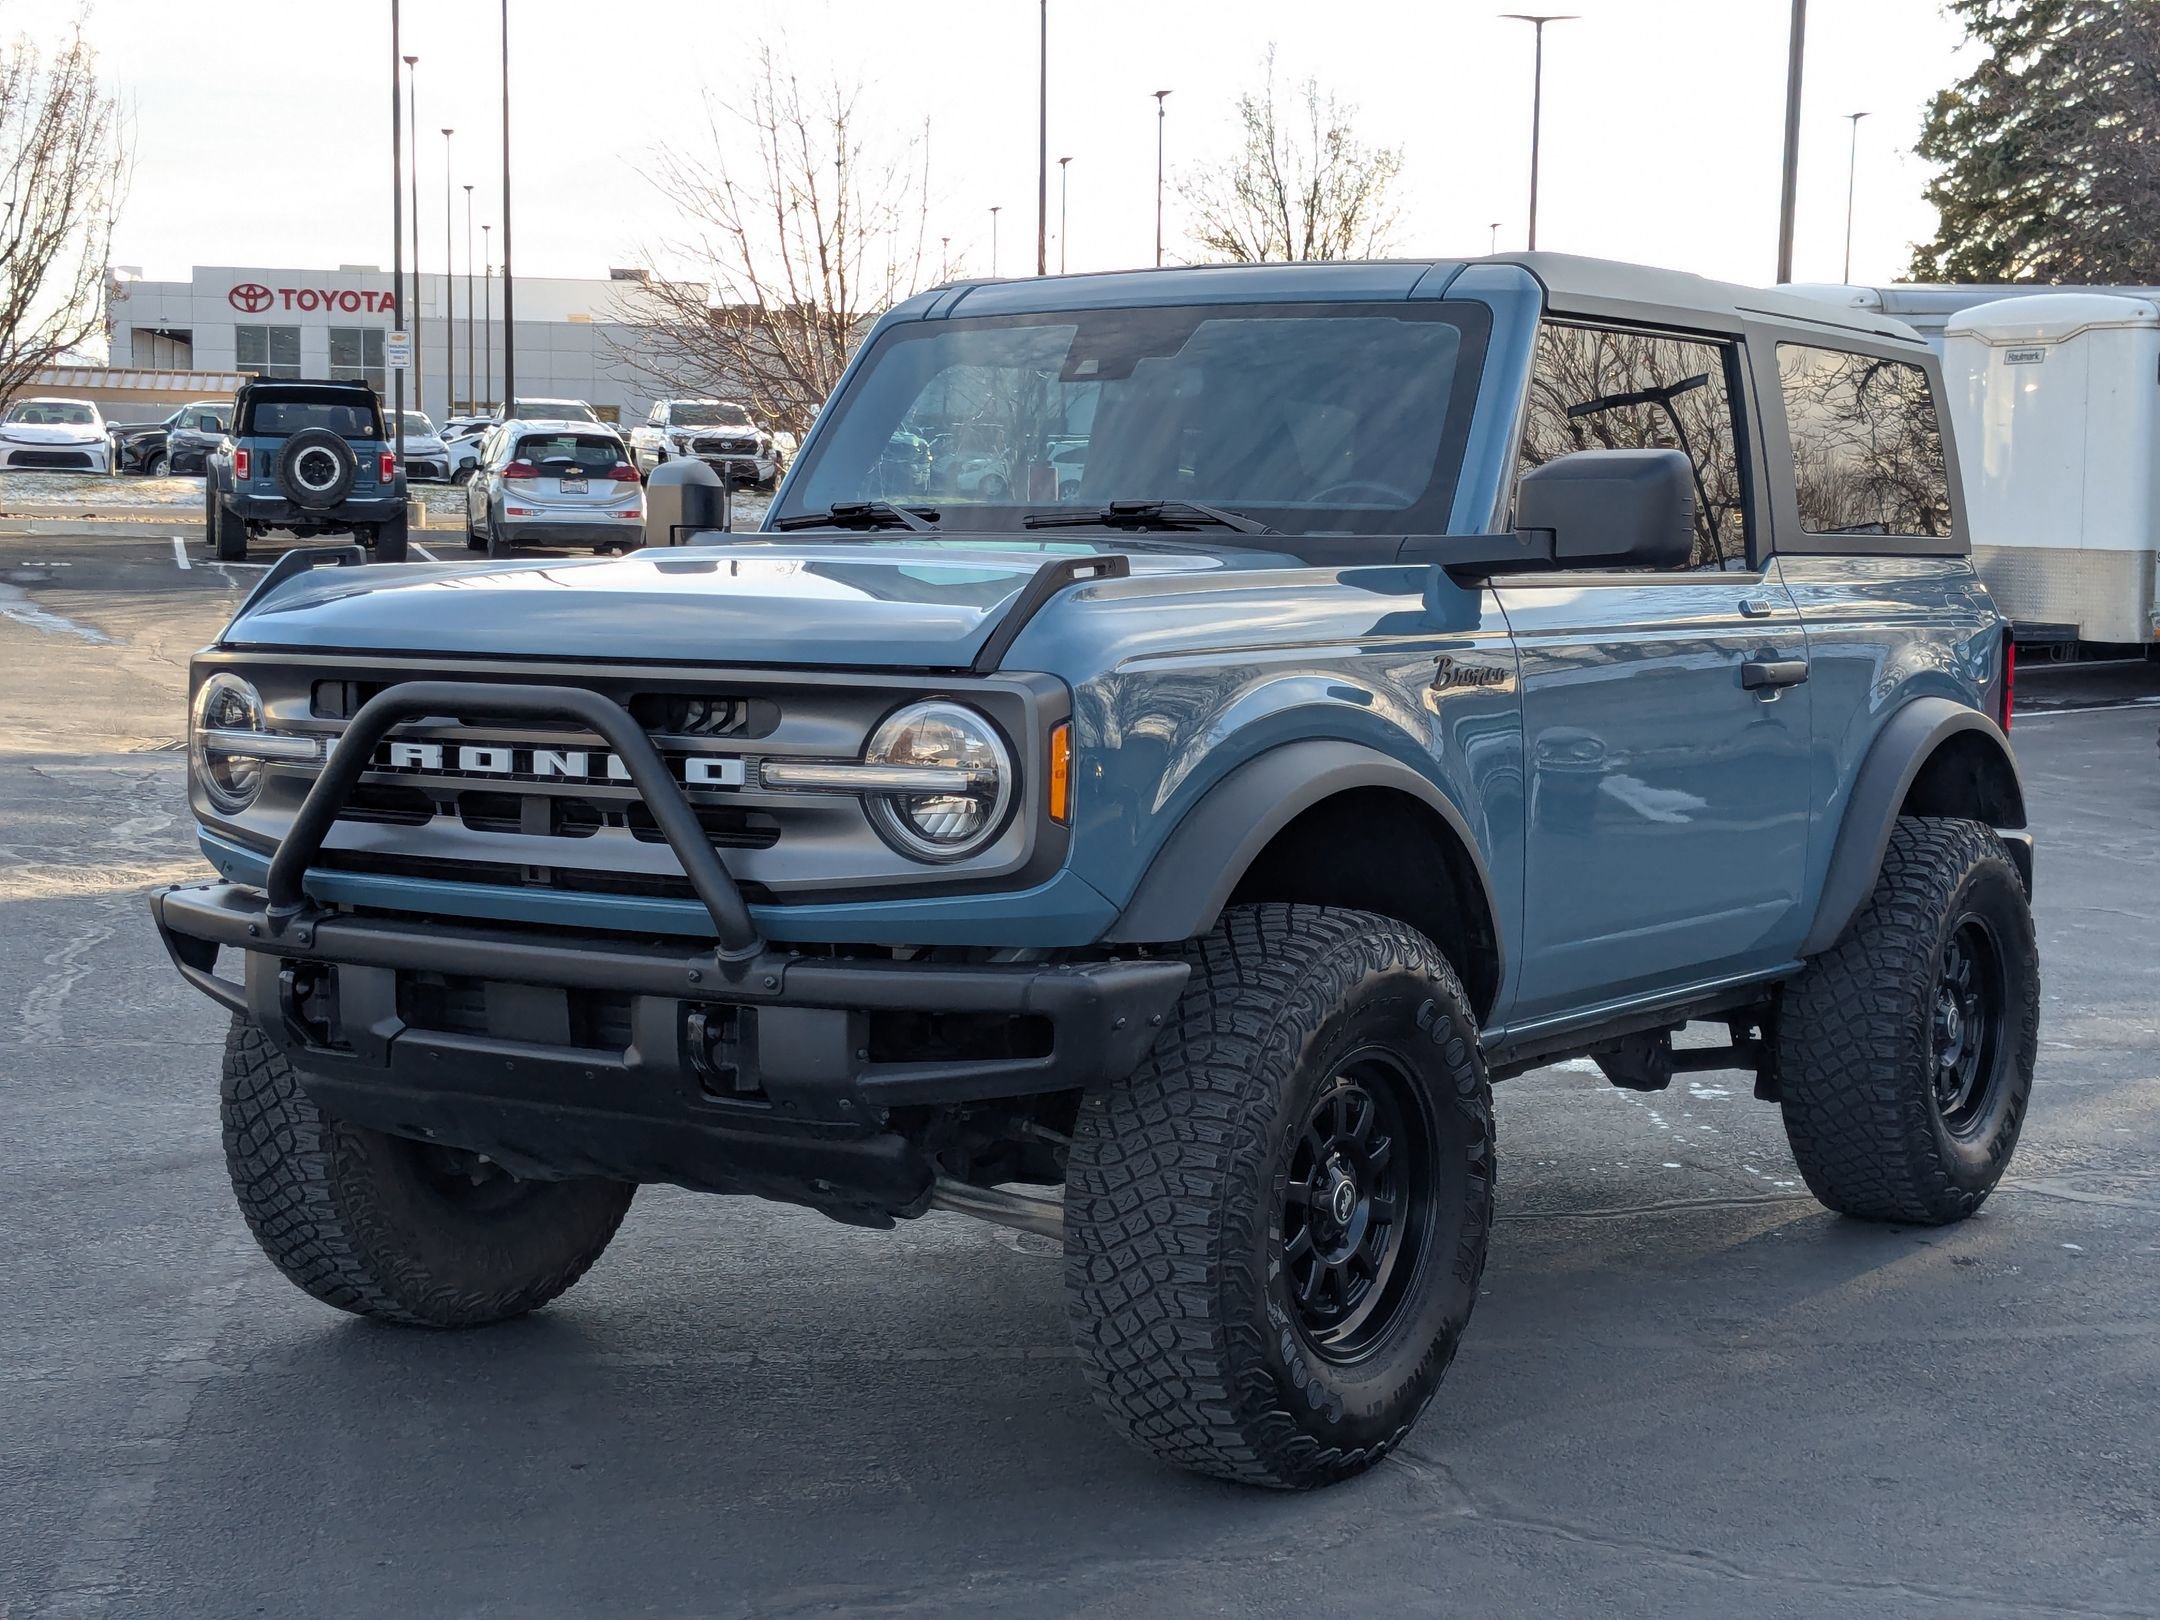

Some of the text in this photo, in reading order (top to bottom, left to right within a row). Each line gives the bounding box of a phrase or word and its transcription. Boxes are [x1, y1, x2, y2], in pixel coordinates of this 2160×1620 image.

[278, 288, 396, 313] TOYOTA
[1429, 654, 1505, 691] Bronco
[326, 738, 745, 786] RONO
